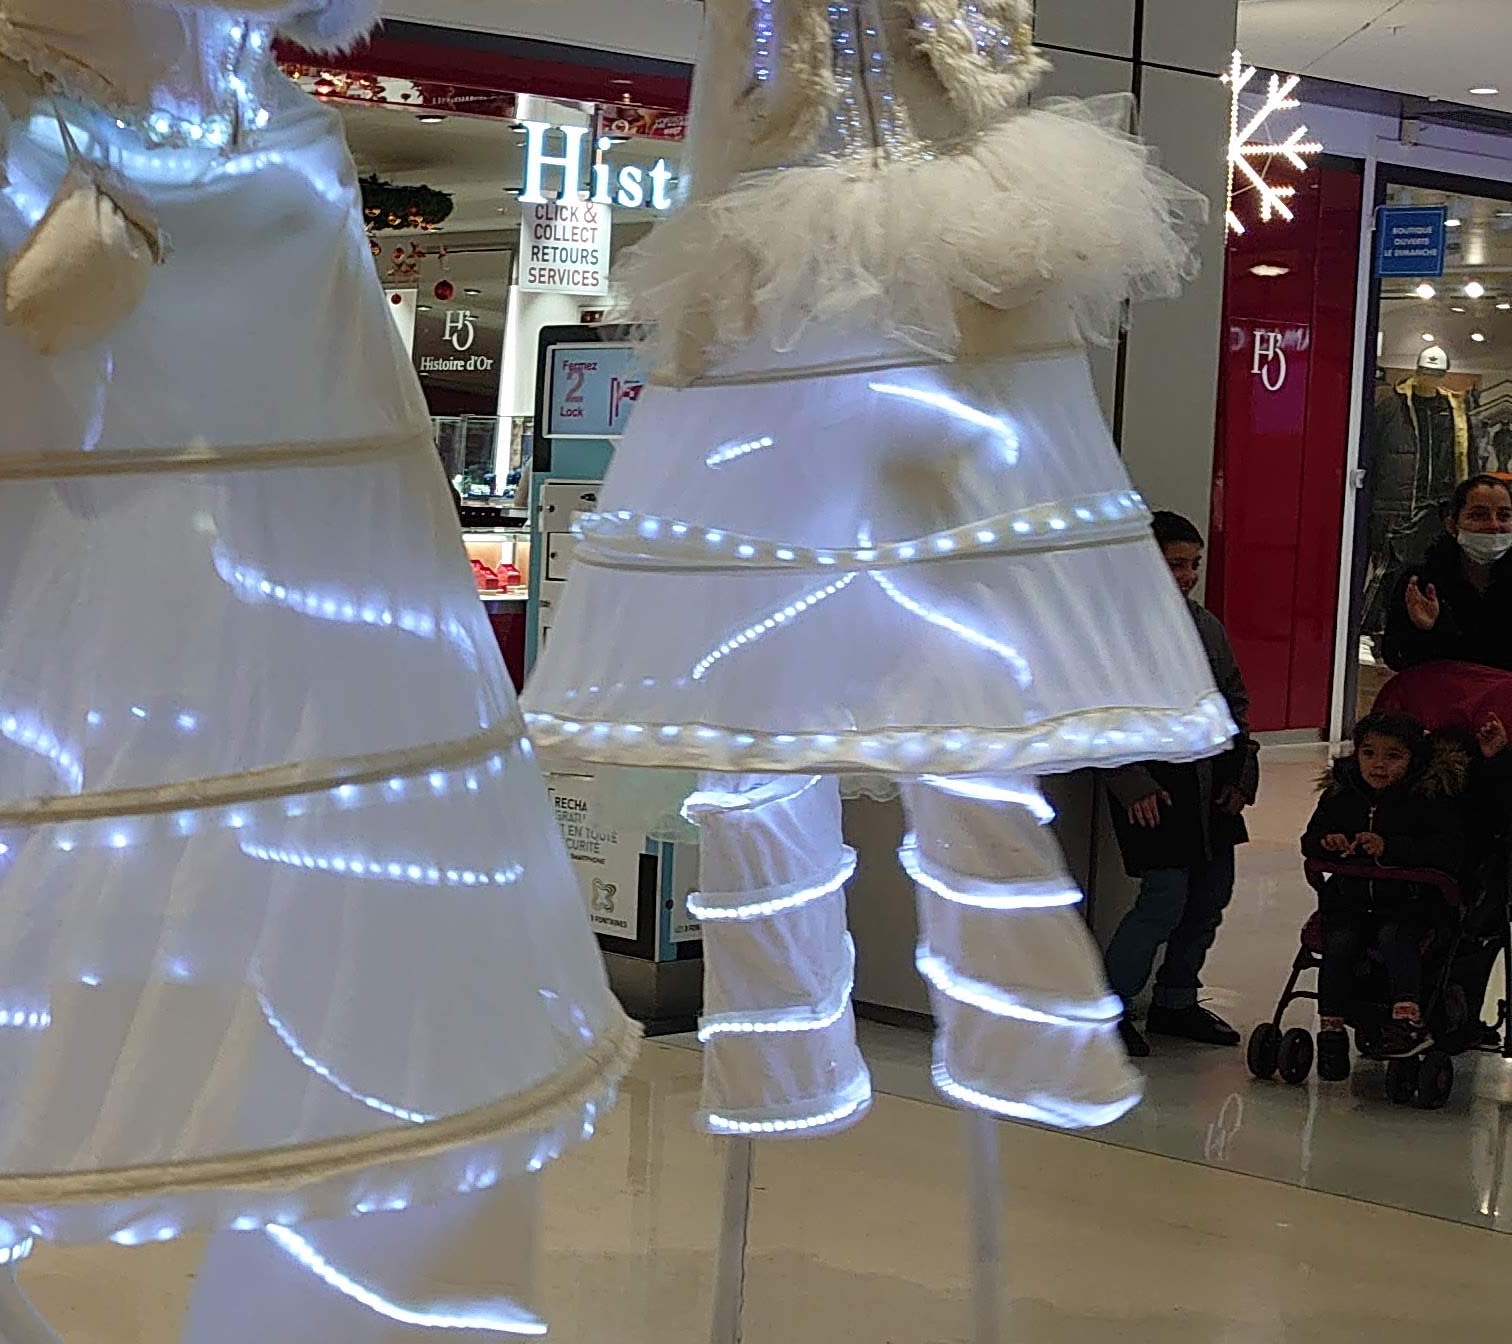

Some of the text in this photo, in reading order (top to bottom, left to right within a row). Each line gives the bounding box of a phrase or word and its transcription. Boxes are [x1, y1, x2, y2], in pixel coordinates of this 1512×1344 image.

[535, 201, 598, 223] CLICK &
[534, 223, 598, 243] COLLECT
[531, 245, 599, 265] RETOURS
[528, 267, 599, 287] SERVICES
[419, 355, 494, 371] Histoire d'Or
[561, 359, 598, 371] Fermez
[565, 369, 584, 403] 2
[559, 406, 584, 417] Lock
